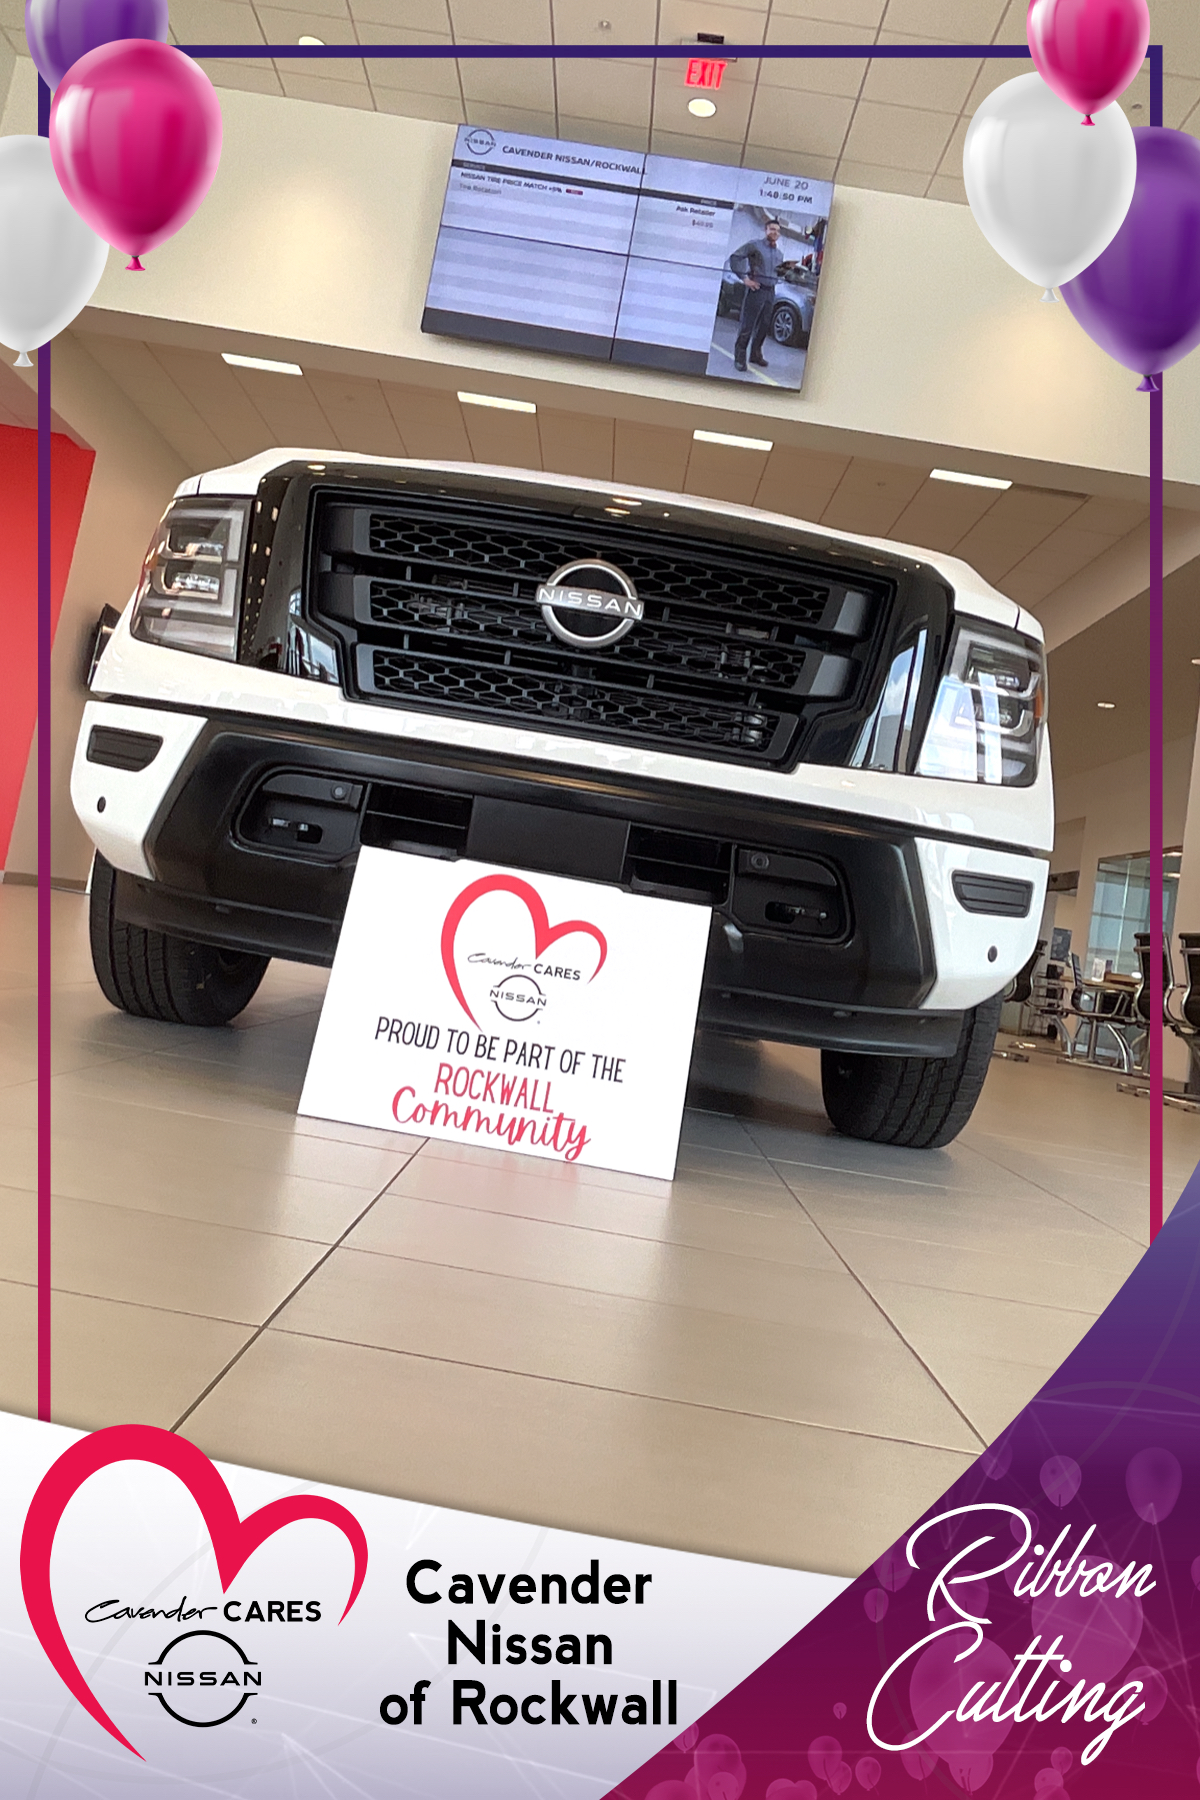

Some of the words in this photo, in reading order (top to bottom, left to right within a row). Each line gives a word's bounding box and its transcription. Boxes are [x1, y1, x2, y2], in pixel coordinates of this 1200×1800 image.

[685, 59, 727, 89] EXIT
[464, 137, 497, 147] NISSAN
[502, 145, 554, 160] CAVENDER
[555, 154, 647, 175] NISSAN/ROCKWALL
[461, 171, 485, 181] NISSAN
[502, 178, 523, 187] PRICE
[523, 181, 548, 191] MATCH
[764, 176, 790, 187] JUNE
[794, 180, 809, 191] 20
[797, 195, 813, 205] PM
[538, 587, 641, 617] NISSAN
[533, 963, 581, 981] CARES
[489, 989, 547, 1007] NISSAN
[375, 1016, 440, 1050] PROUD
[447, 1028, 470, 1055] TO
[474, 1034, 500, 1061] BE
[503, 1039, 555, 1070] PART
[559, 1049, 586, 1075] OF
[592, 1054, 626, 1083] THE
[434, 1062, 554, 1113] ROCKWALL
[392, 1086, 592, 1162] Community
